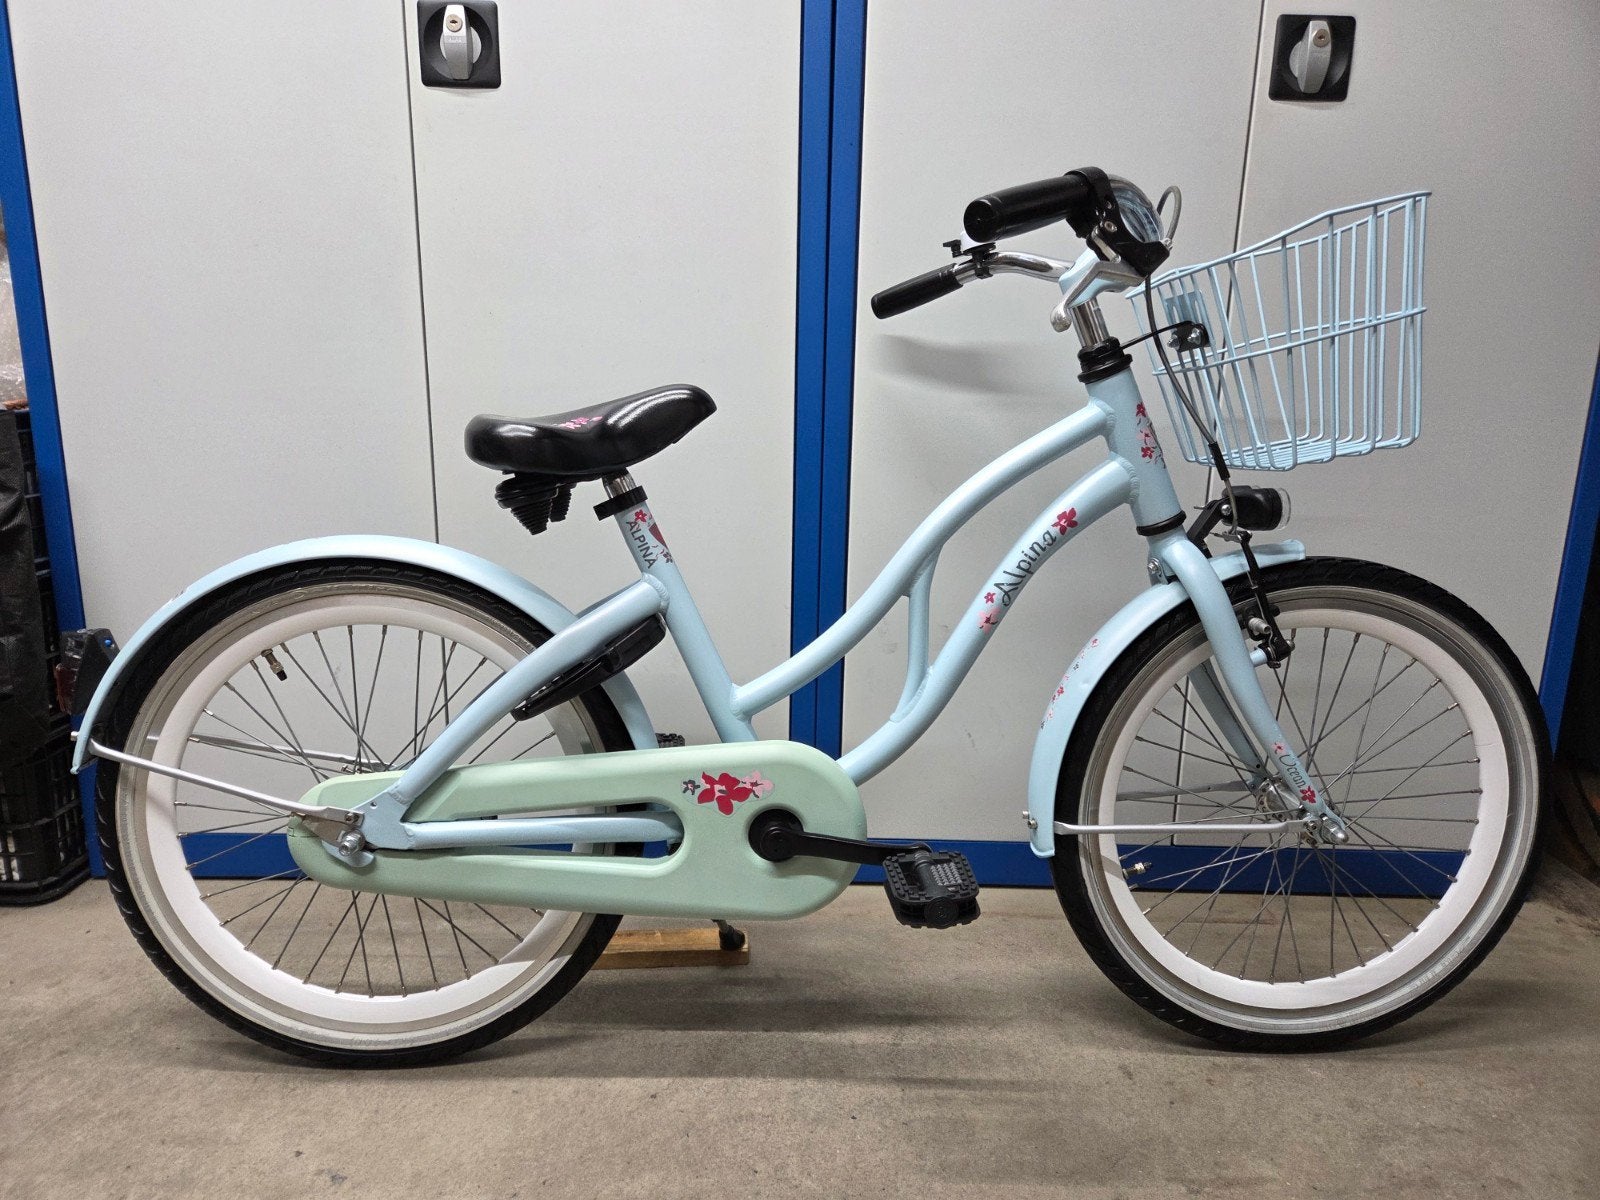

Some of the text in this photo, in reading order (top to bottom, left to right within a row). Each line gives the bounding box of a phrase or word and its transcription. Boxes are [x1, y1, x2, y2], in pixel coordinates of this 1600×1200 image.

[626, 521, 657, 569] ALPINA
[994, 530, 1057, 607] Alpina
[1279, 754, 1306, 788] Ocean
